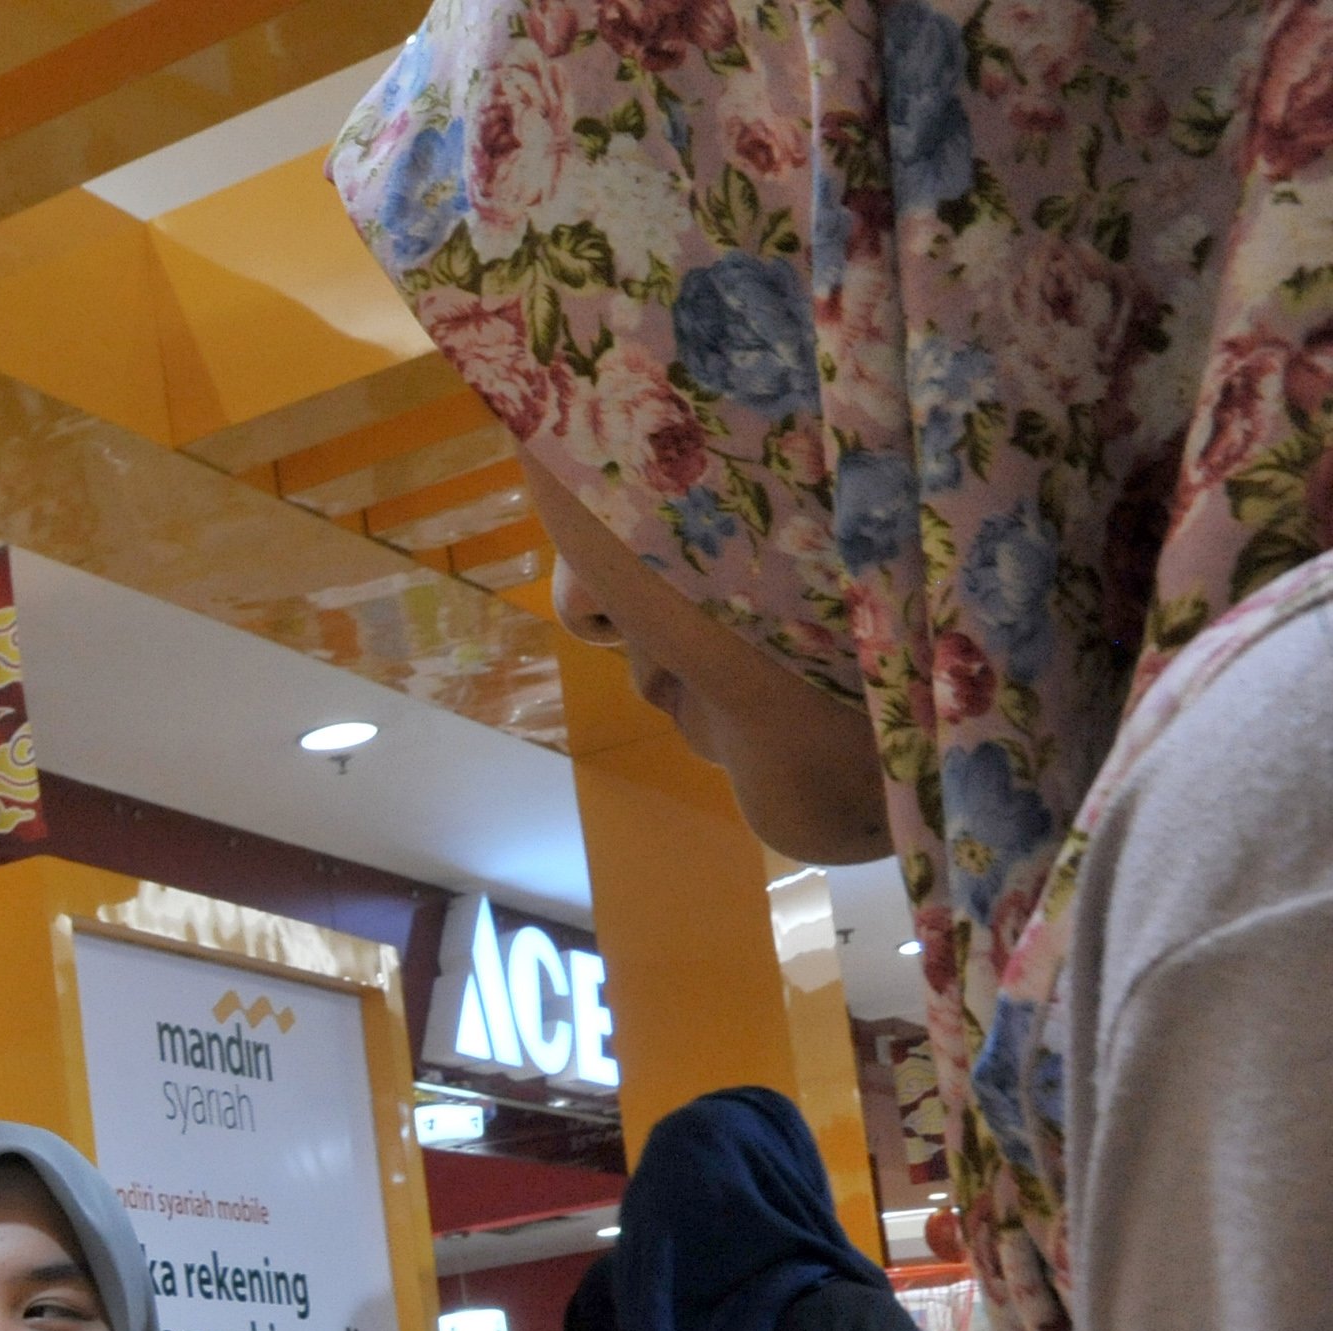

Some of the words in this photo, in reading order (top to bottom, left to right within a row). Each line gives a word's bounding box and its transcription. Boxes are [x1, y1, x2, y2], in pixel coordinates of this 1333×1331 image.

[455, 894, 620, 1088] ACE
[156, 1021, 273, 1082] mandiri
[163, 1080, 256, 1134] syariah
[116, 1181, 154, 1212] ndiri
[157, 1190, 214, 1220] syariah
[217, 1195, 269, 1225] mobile
[139, 1243, 177, 1297] ka
[183, 1250, 310, 1319] rekening
